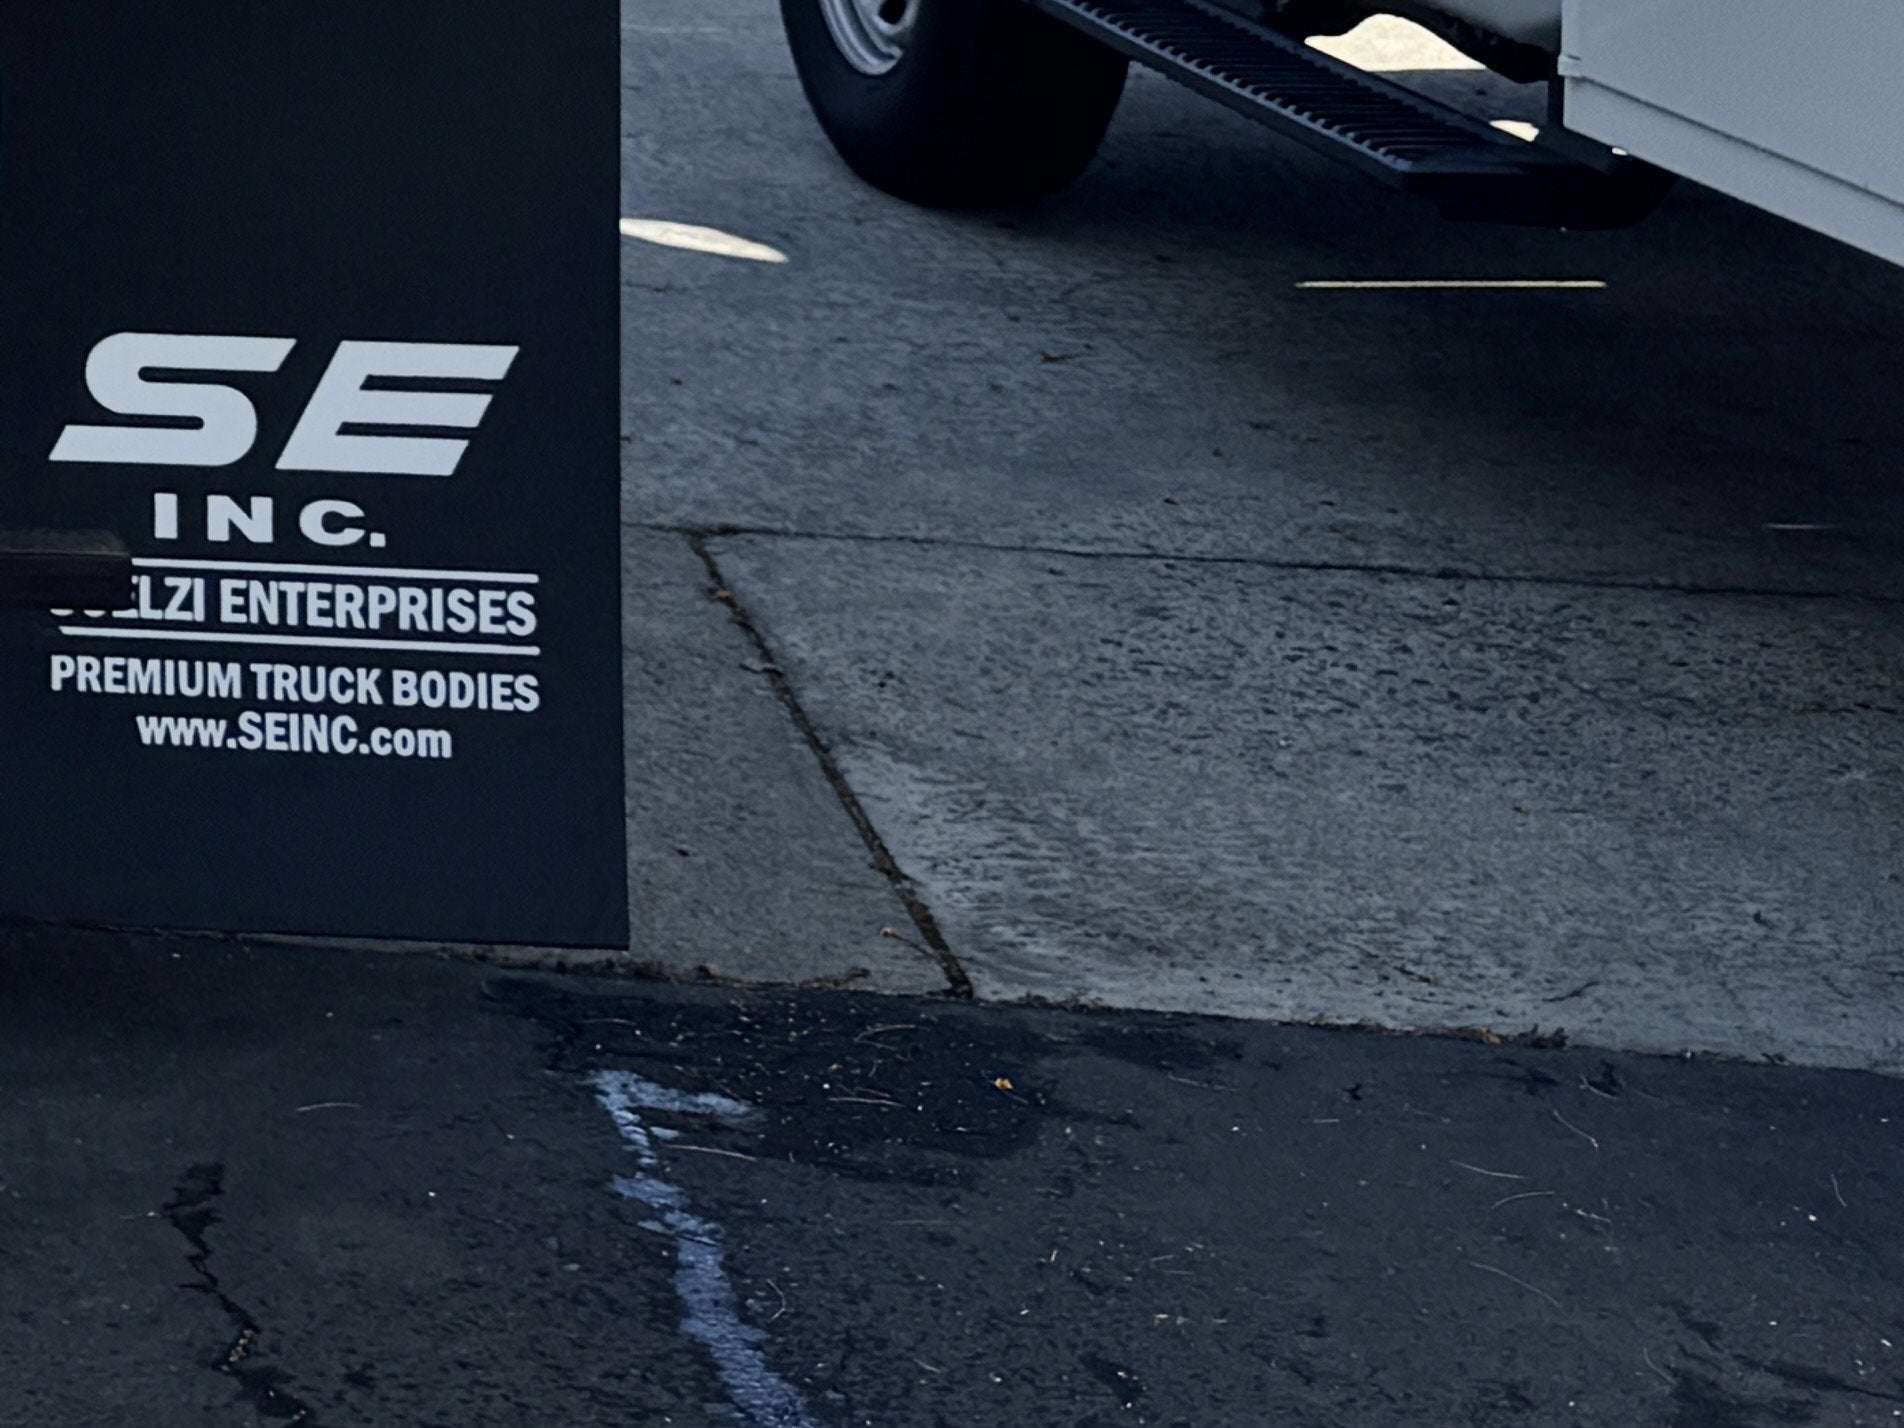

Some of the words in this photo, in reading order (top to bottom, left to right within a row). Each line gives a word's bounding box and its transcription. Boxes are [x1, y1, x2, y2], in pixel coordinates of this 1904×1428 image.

[47, 331, 521, 477] SE
[153, 491, 387, 548] INC.
[219, 577, 538, 637] ENTERPRISES
[49, 653, 242, 700] PREMIUM
[249, 662, 385, 707] TRUCK
[392, 668, 541, 713] BODIES
[135, 710, 453, 759] www.SEINC.com
